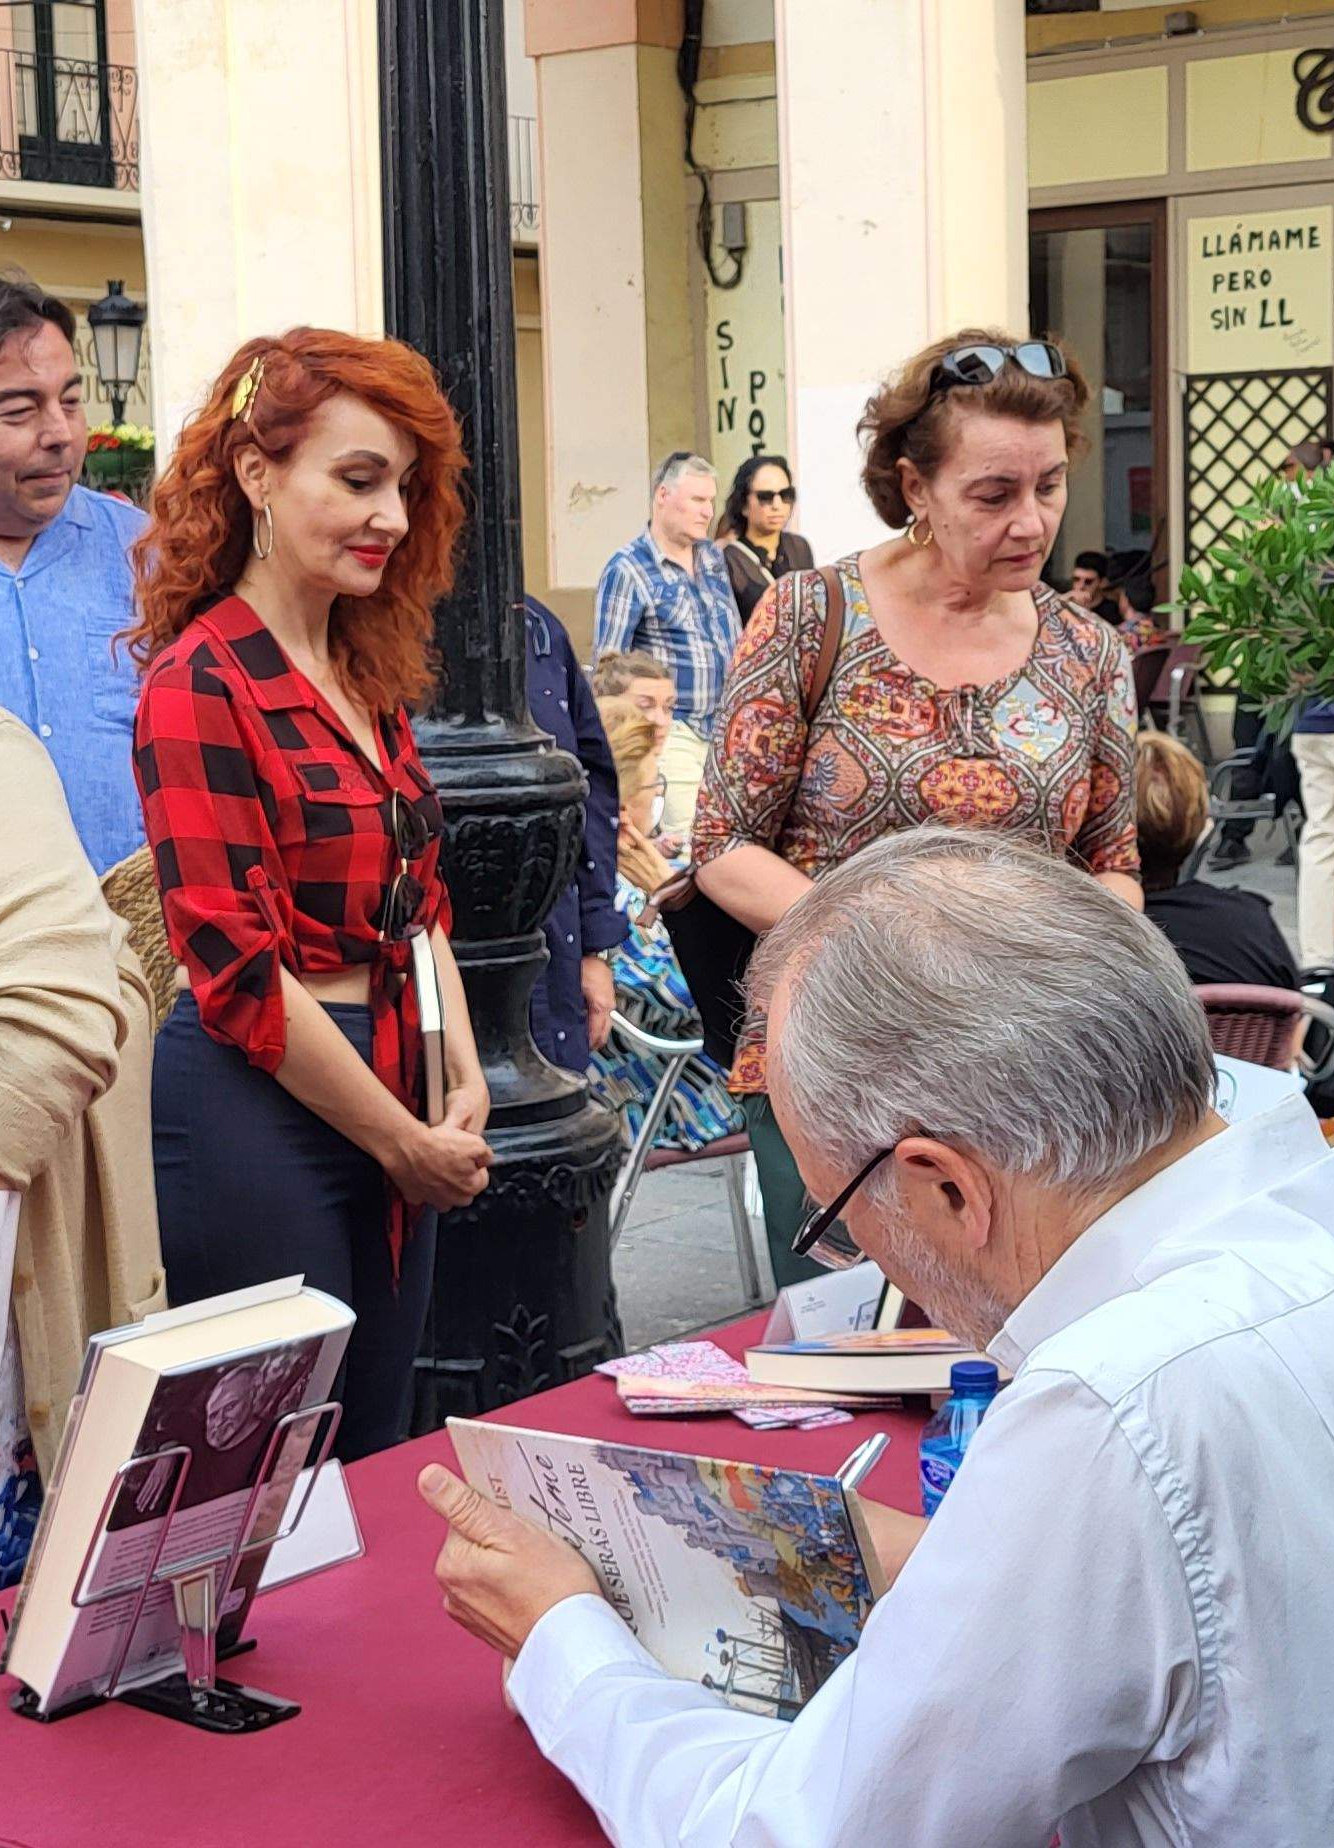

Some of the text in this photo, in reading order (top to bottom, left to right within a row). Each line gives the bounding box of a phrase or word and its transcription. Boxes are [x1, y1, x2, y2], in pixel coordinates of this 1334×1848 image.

[1202, 223, 1321, 258] LLÁMAME
[1212, 269, 1272, 294] PERO
[1210, 298, 1294, 331] SIN LL
[716, 320, 738, 433] SIN
[567, 1461, 603, 1524] LIBRE
[609, 1587, 639, 1636] UE
